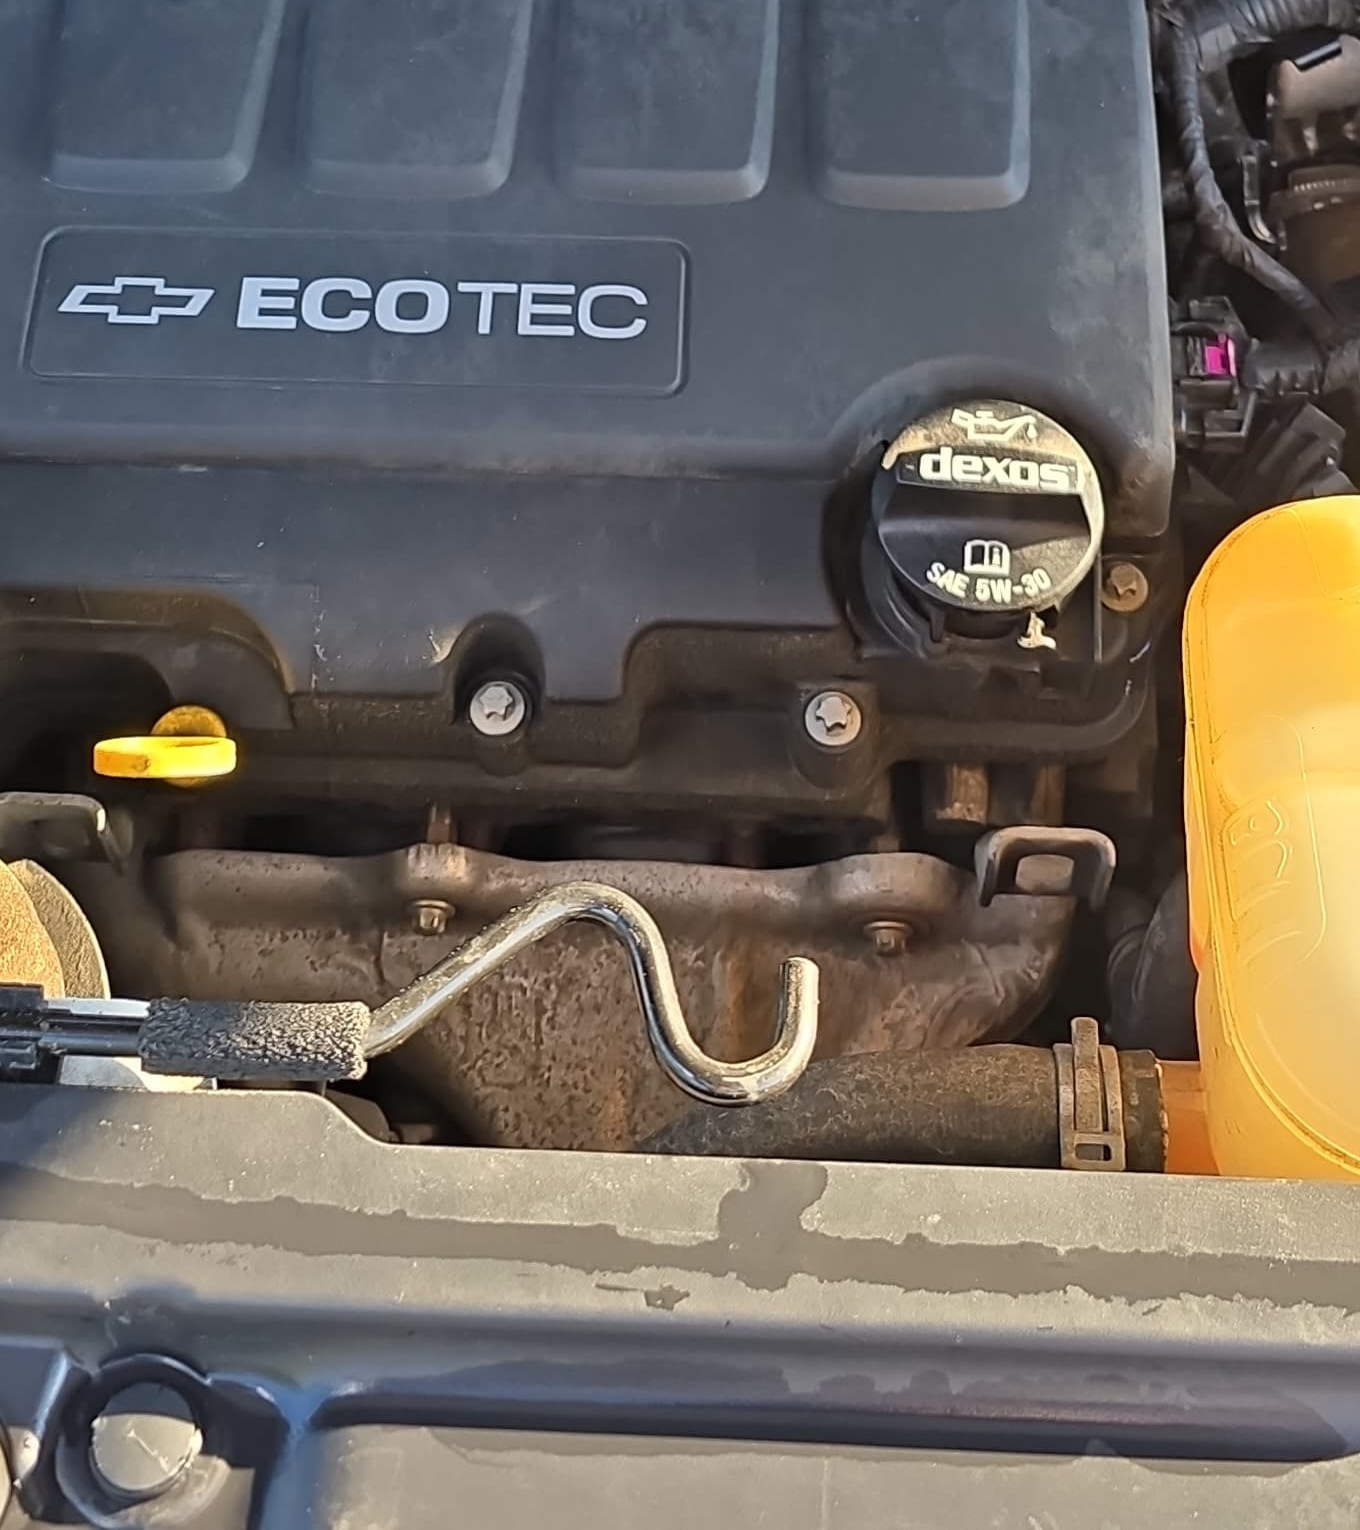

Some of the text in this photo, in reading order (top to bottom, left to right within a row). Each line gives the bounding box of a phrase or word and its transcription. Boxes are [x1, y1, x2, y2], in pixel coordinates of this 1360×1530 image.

[235, 275, 650, 342] ECOTEC
[919, 446, 1070, 490] dexos
[926, 561, 1052, 604] SAE 5W-30
